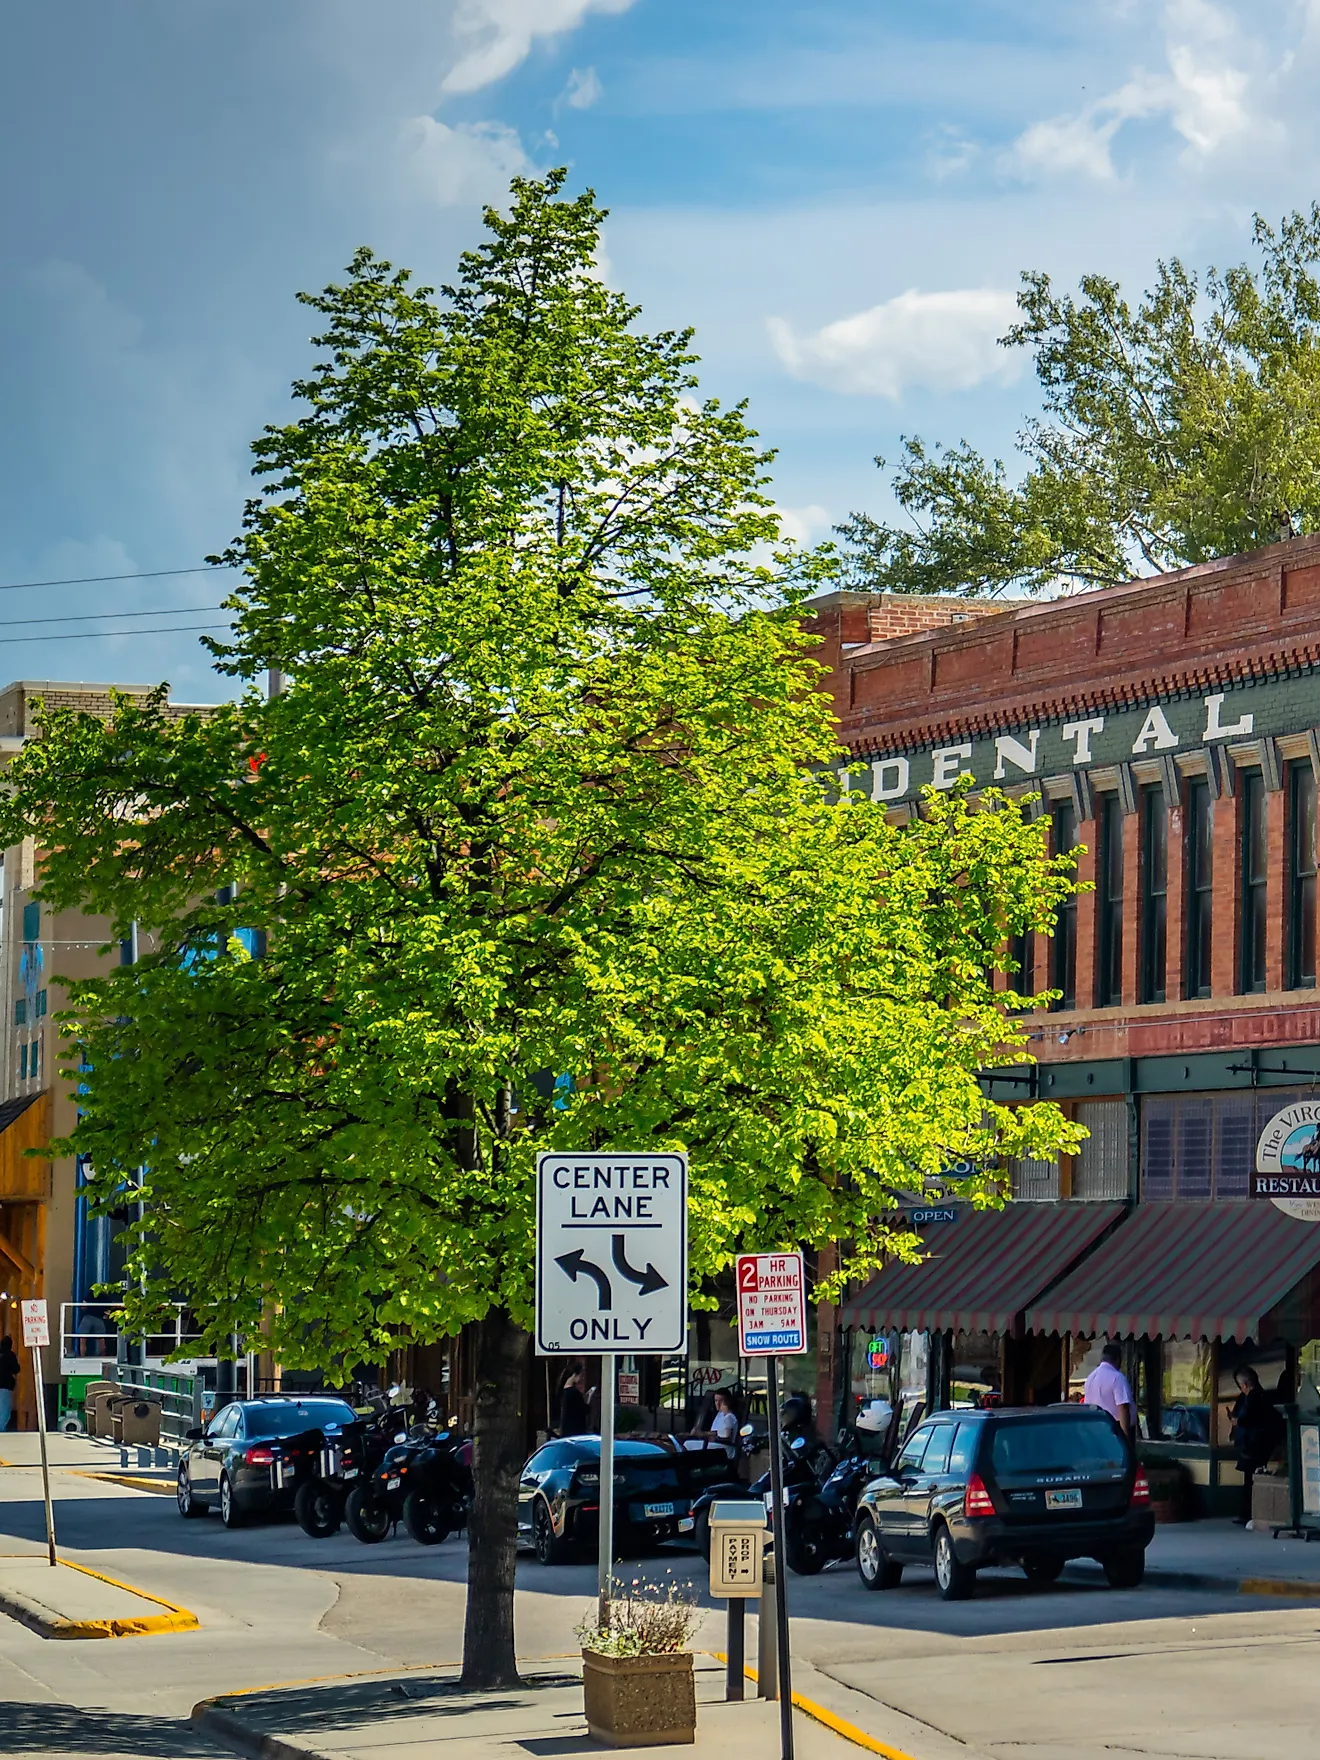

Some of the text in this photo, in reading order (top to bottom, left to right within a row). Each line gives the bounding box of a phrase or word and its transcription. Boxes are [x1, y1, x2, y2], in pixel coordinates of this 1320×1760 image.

[815, 693, 1255, 806] IDENTAL
[1262, 1129, 1284, 1161] The
[553, 1166, 670, 1189] CENTER
[571, 1196, 653, 1218] LANE
[913, 1210, 954, 1221] OPEN
[742, 1263, 756, 1287] 2
[770, 1260, 786, 1272] HR
[759, 1275, 798, 1288] PARKING
[749, 1294, 793, 1304] NO PARKING
[745, 1306, 797, 1317] ON THURSDAY
[570, 1318, 653, 1340] ONLY
[749, 1321, 764, 1330] 3AM
[780, 1319, 796, 1328] 5AM
[746, 1334, 799, 1345] SNOW ROUTE
[693, 1367, 721, 1385] AAA
[1036, 1475, 1090, 1483] SUBARU
[740, 1538, 750, 1561] DROP
[728, 1538, 738, 1580] PAYMENT
